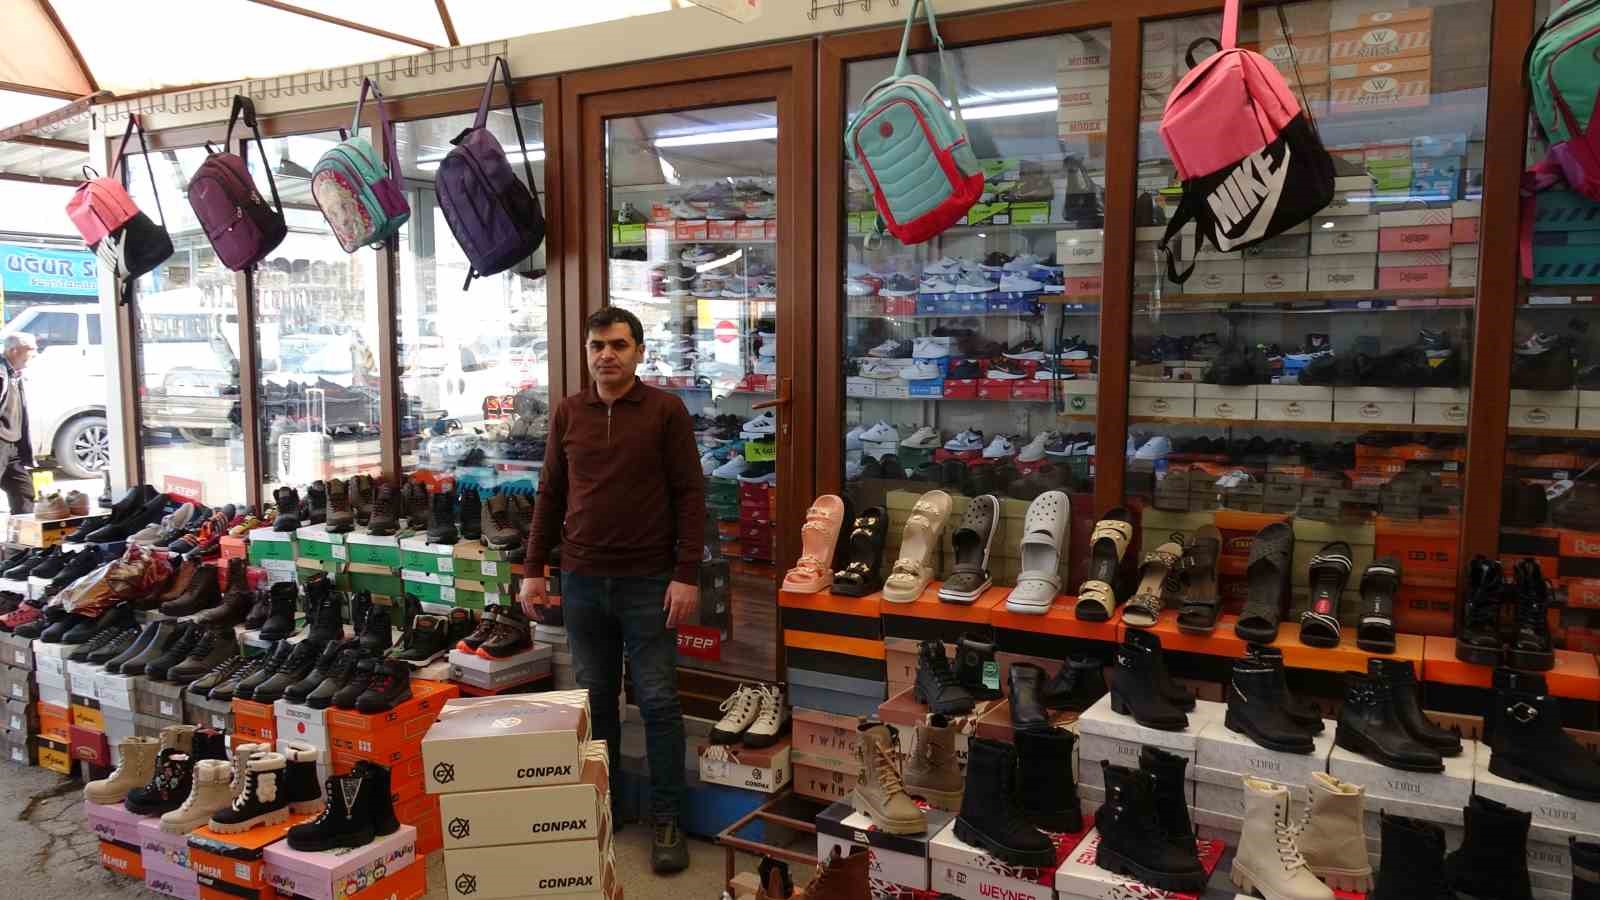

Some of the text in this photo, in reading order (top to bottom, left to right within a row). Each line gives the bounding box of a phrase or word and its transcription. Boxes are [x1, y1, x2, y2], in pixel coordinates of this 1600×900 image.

[1207, 144, 1281, 234] NIKE
[516, 765, 572, 779] CONPAX
[532, 819, 587, 833] CONPAX
[538, 876, 594, 889] CONPAX
